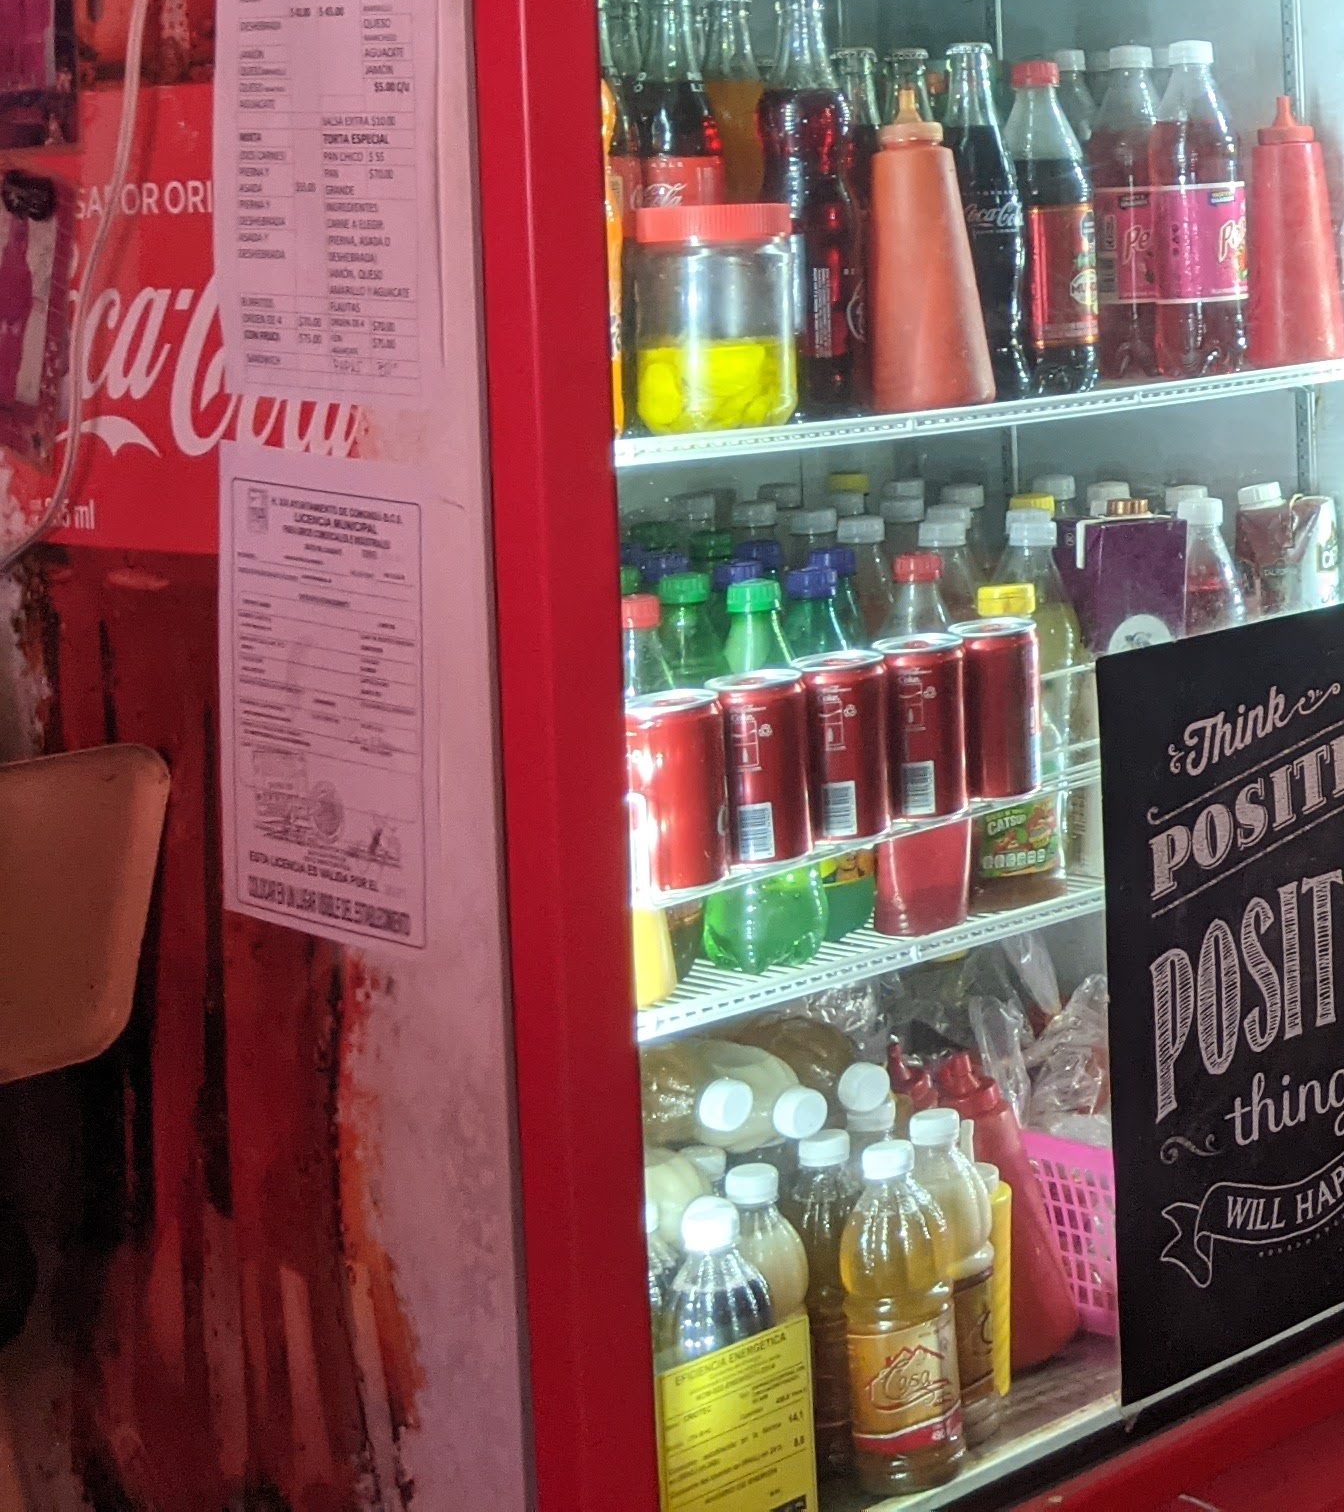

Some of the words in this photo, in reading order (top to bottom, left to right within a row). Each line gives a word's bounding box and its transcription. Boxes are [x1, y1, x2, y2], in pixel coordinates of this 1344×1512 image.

[363, 18, 391, 29] QUESO
[364, 46, 404, 58] AGUACATE
[322, 133, 350, 145] TORTA
[351, 133, 390, 145] ESPECIAL
[358, 269, 383, 280] QUESO
[1184, 685, 1292, 777] Think
[1226, 1192, 1287, 1231] WILL
